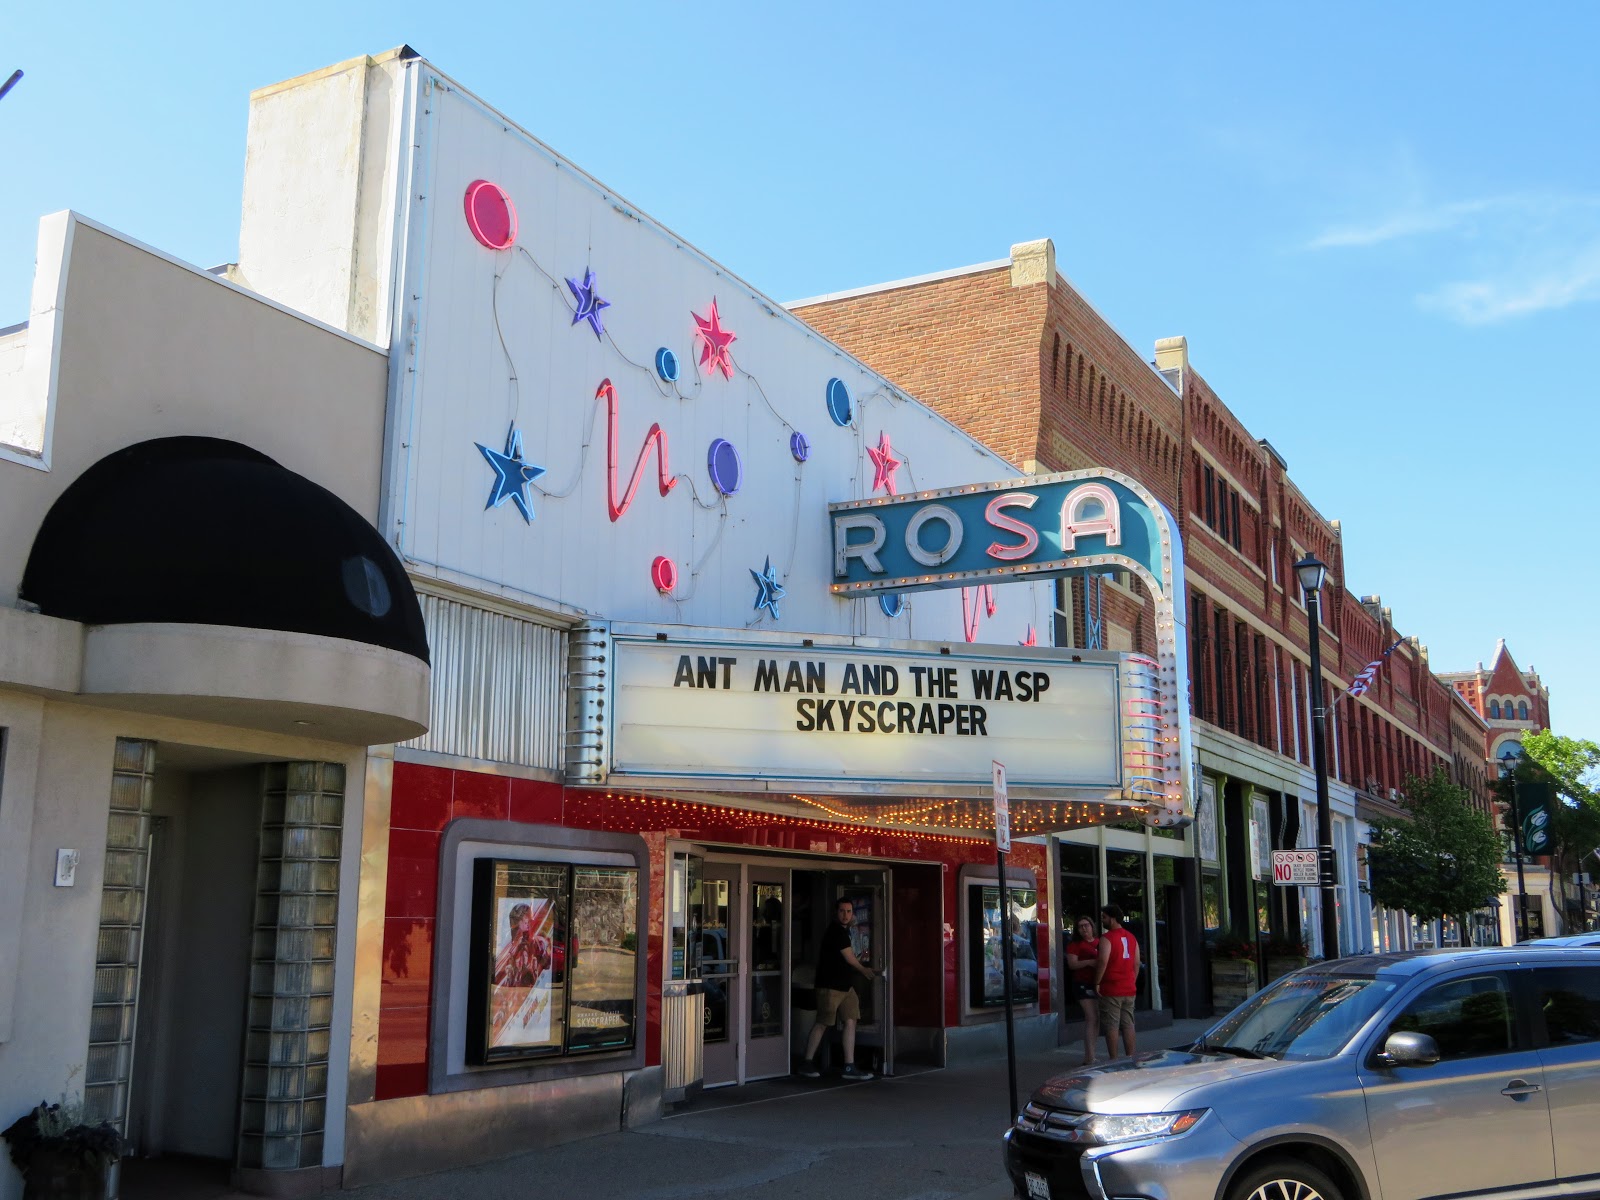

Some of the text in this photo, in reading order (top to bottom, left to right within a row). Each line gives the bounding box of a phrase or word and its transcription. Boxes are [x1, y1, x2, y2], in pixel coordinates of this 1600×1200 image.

[834, 482, 1121, 578] ROSA
[673, 654, 1051, 703] ANT MAN AND THE WASP
[796, 698, 988, 736] SKYSCRAPER
[1275, 864, 1291, 880] NO
[1120, 936, 1130, 959] 1
[576, 1015, 620, 1028] SKYSCRAPER
